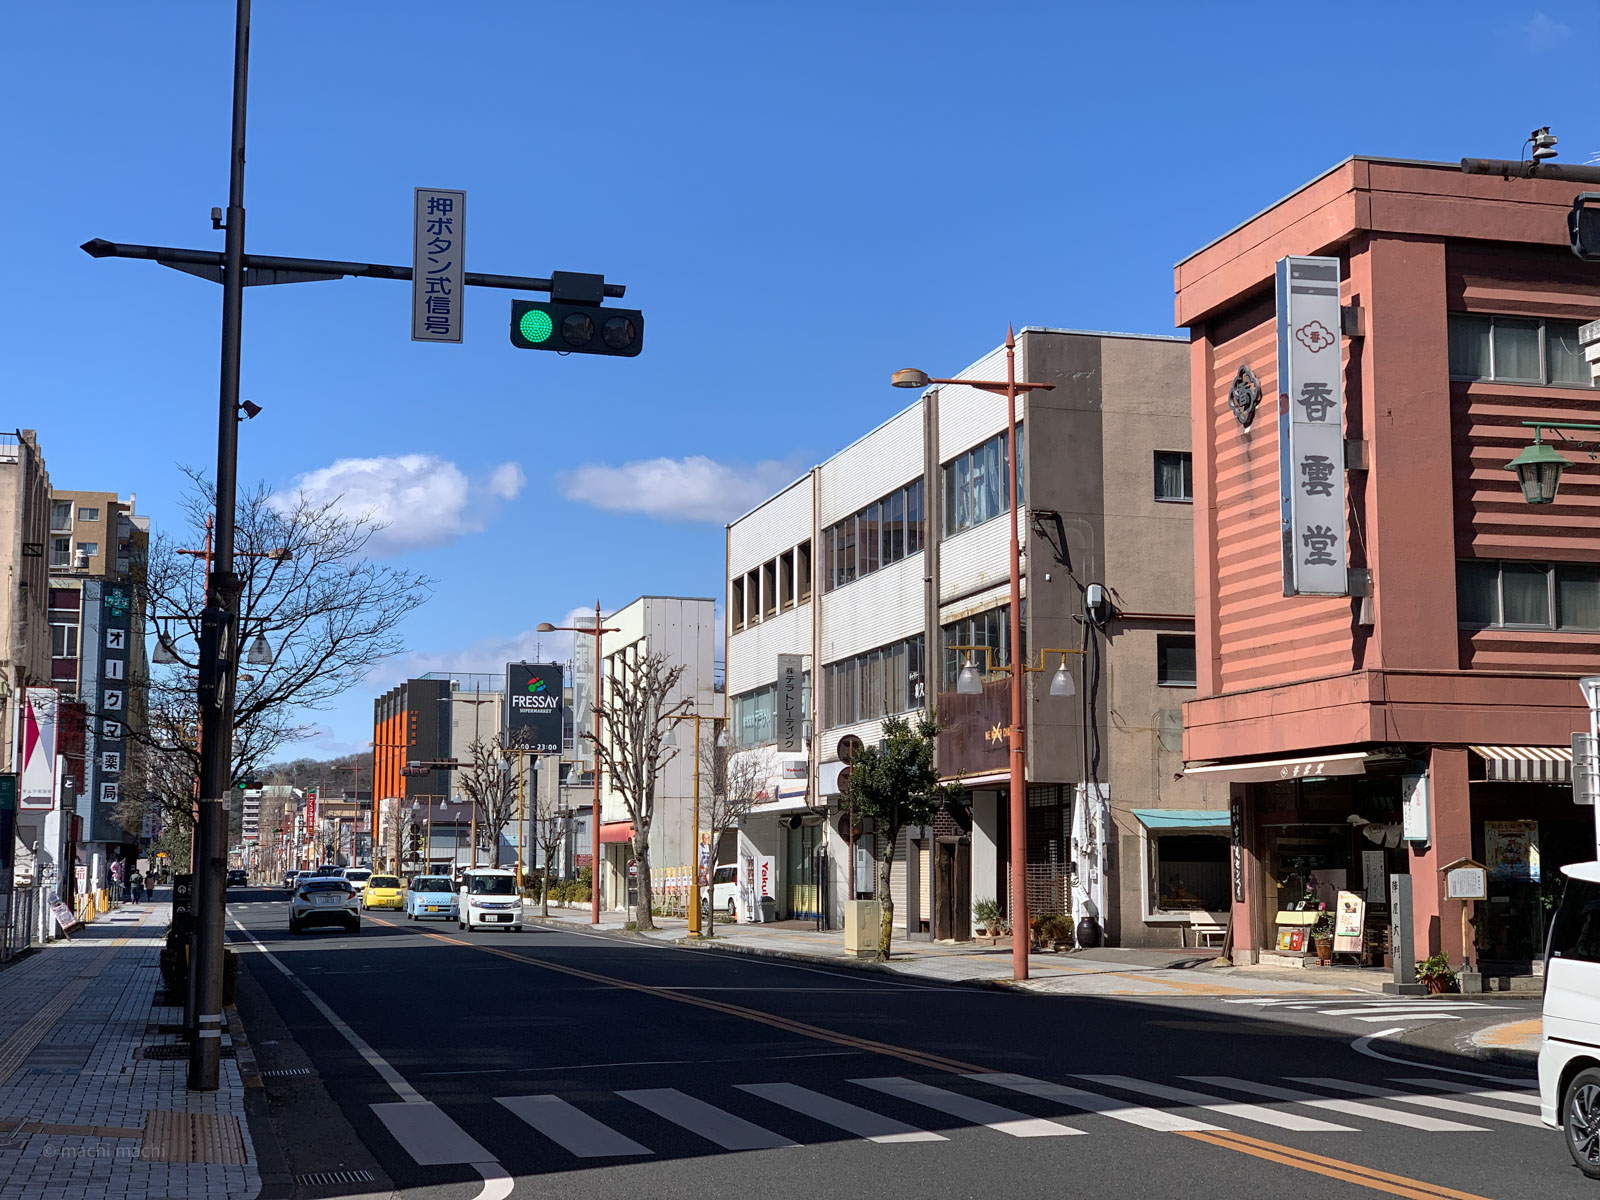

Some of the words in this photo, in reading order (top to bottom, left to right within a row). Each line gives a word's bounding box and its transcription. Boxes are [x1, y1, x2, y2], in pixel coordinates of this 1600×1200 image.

[424, 196, 453, 335] 押ボタン式信号
[1297, 382, 1338, 567] 香雲堂
[103, 631, 123, 800] オークマ薬局
[512, 695, 559, 708] FRESSAY
[761, 862, 769, 895] Yakul
[1392, 881, 1401, 959] 陣屋大門
